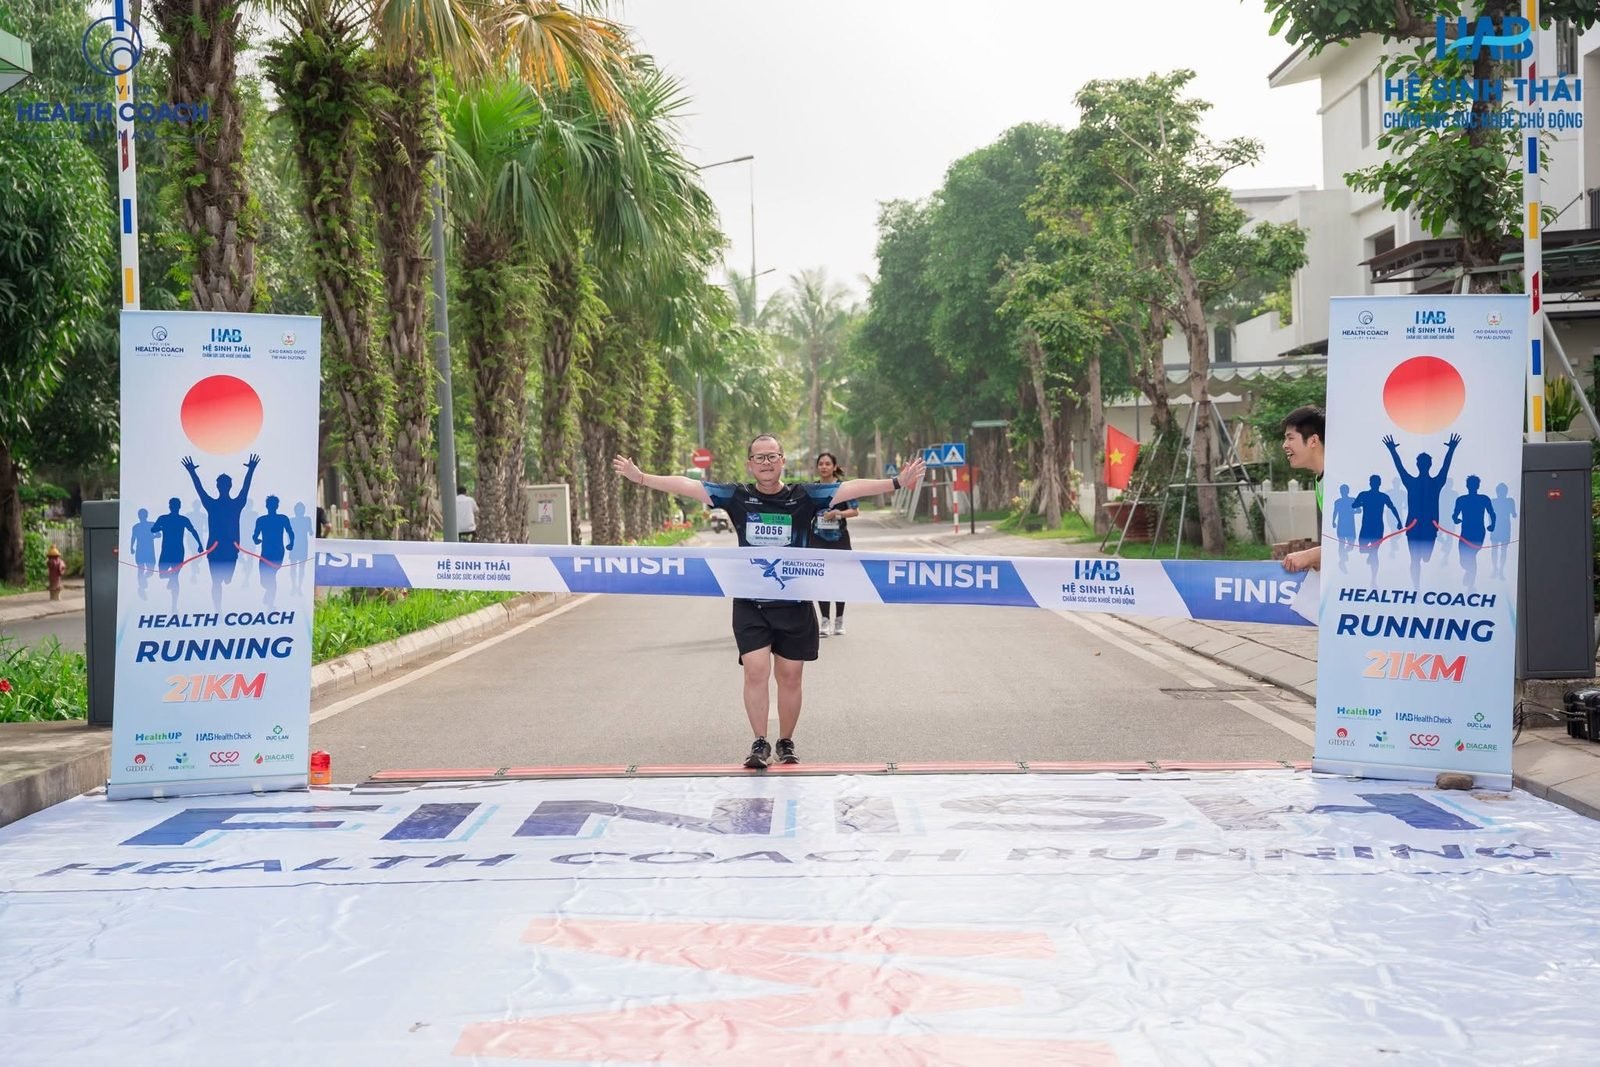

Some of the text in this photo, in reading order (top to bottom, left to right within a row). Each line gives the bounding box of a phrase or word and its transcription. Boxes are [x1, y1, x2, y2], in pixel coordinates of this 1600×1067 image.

[1416, 311, 1446, 325] HAB
[211, 328, 242, 343] HAB
[234, 345, 251, 353] THÁI
[755, 525, 783, 535] 20056
[437, 558, 510, 572] HỆ SINH THÁI
[573, 557, 686, 576] FINISH
[782, 566, 825, 577] RUNNING
[1075, 559, 1120, 581] HAB
[888, 560, 999, 589] FINISH
[1062, 582, 1134, 595] HỆ SINH THÁI
[1214, 577, 1304, 606] FINIS
[1338, 588, 1497, 608] HEALTH COACH
[138, 611, 295, 629] HEALTH COACH
[1336, 613, 1496, 643] RUNNING
[135, 636, 294, 663] RUNNING
[1361, 651, 1468, 683] 21KM
[162, 672, 267, 703] 21KM
[1337, 706, 1382, 717] HealthUP
[135, 731, 182, 742] HealthUP
[1466, 742, 1498, 750] DIACARE
[265, 753, 294, 761] DIACARE
[36, 852, 518, 877] HEALTH
[549, 848, 966, 865] COACH
